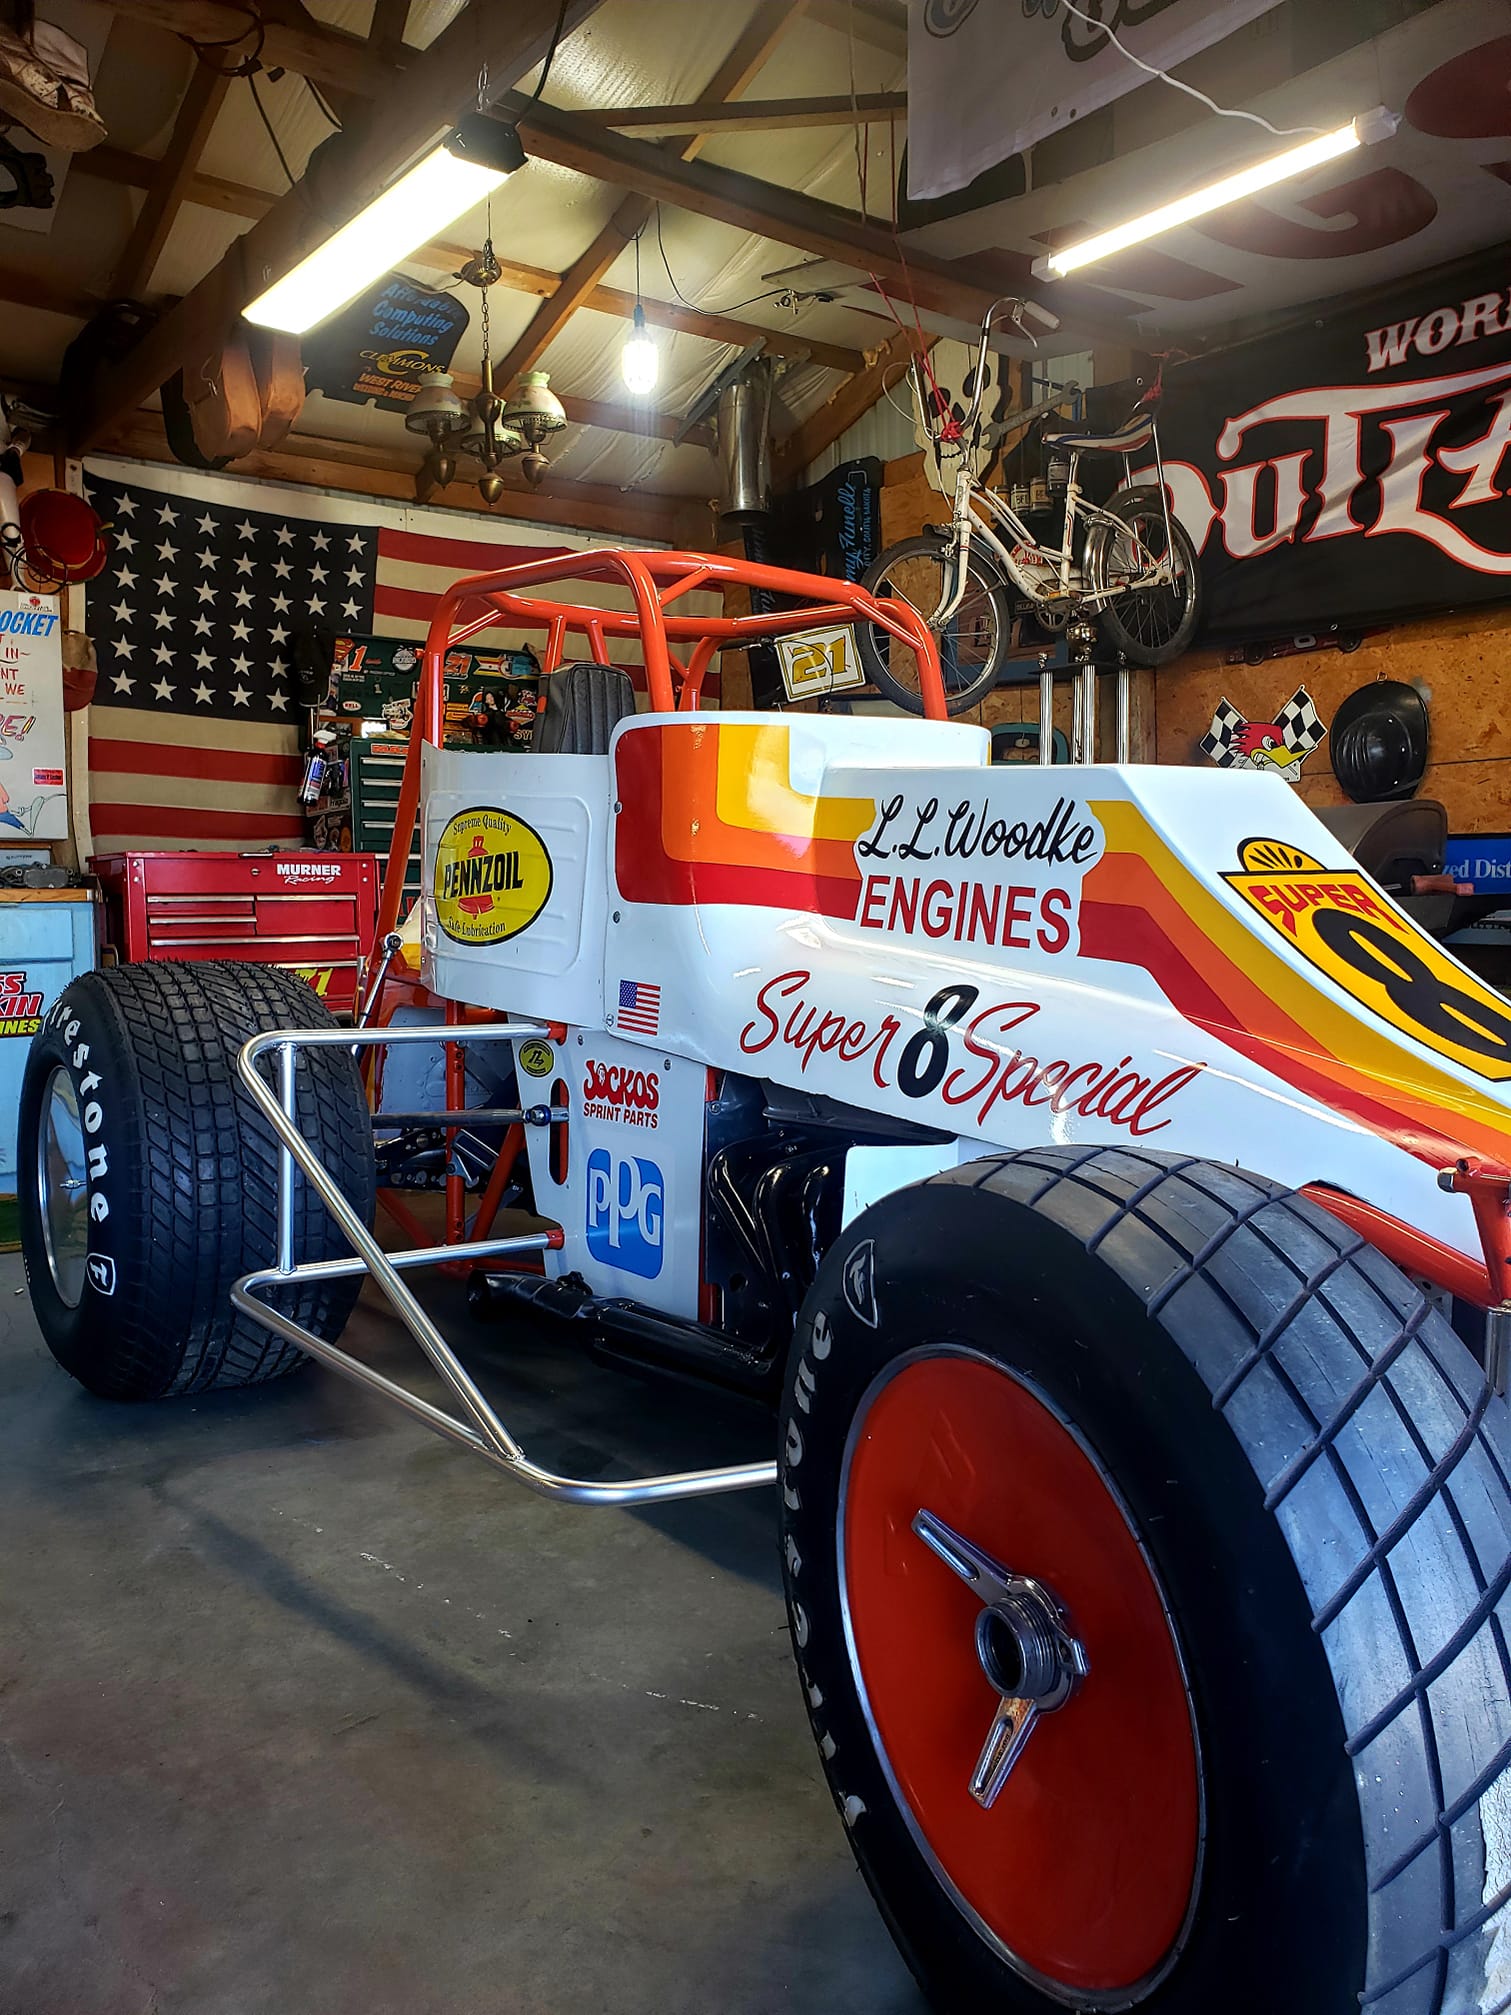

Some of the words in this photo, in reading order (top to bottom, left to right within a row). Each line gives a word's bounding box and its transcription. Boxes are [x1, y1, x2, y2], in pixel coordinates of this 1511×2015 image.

[370, 321, 439, 346] Solutions
[373, 300, 454, 334] Computing
[791, 635, 847, 685] 21
[5, 683, 25, 696] WE
[453, 817, 481, 836] Supreme
[483, 814, 512, 836] Quality
[276, 863, 342, 877] MURNER
[283, 875, 335, 885] Racing
[443, 851, 524, 900] PENNZOIL
[462, 921, 506, 937] Lubrication
[860, 874, 1072, 954] ENGINES
[1247, 884, 1411, 938] SUPER
[1312, 908, 1511, 1064] 8
[740, 970, 901, 1088] Super
[897, 984, 980, 1098] 8
[942, 1002, 1208, 1136] Special
[583, 1060, 659, 1111] JOCKOS
[583, 1102, 621, 1122] SPRINT
[623, 1109, 659, 1130] PARTS
[588, 1150, 663, 1249] PPG
